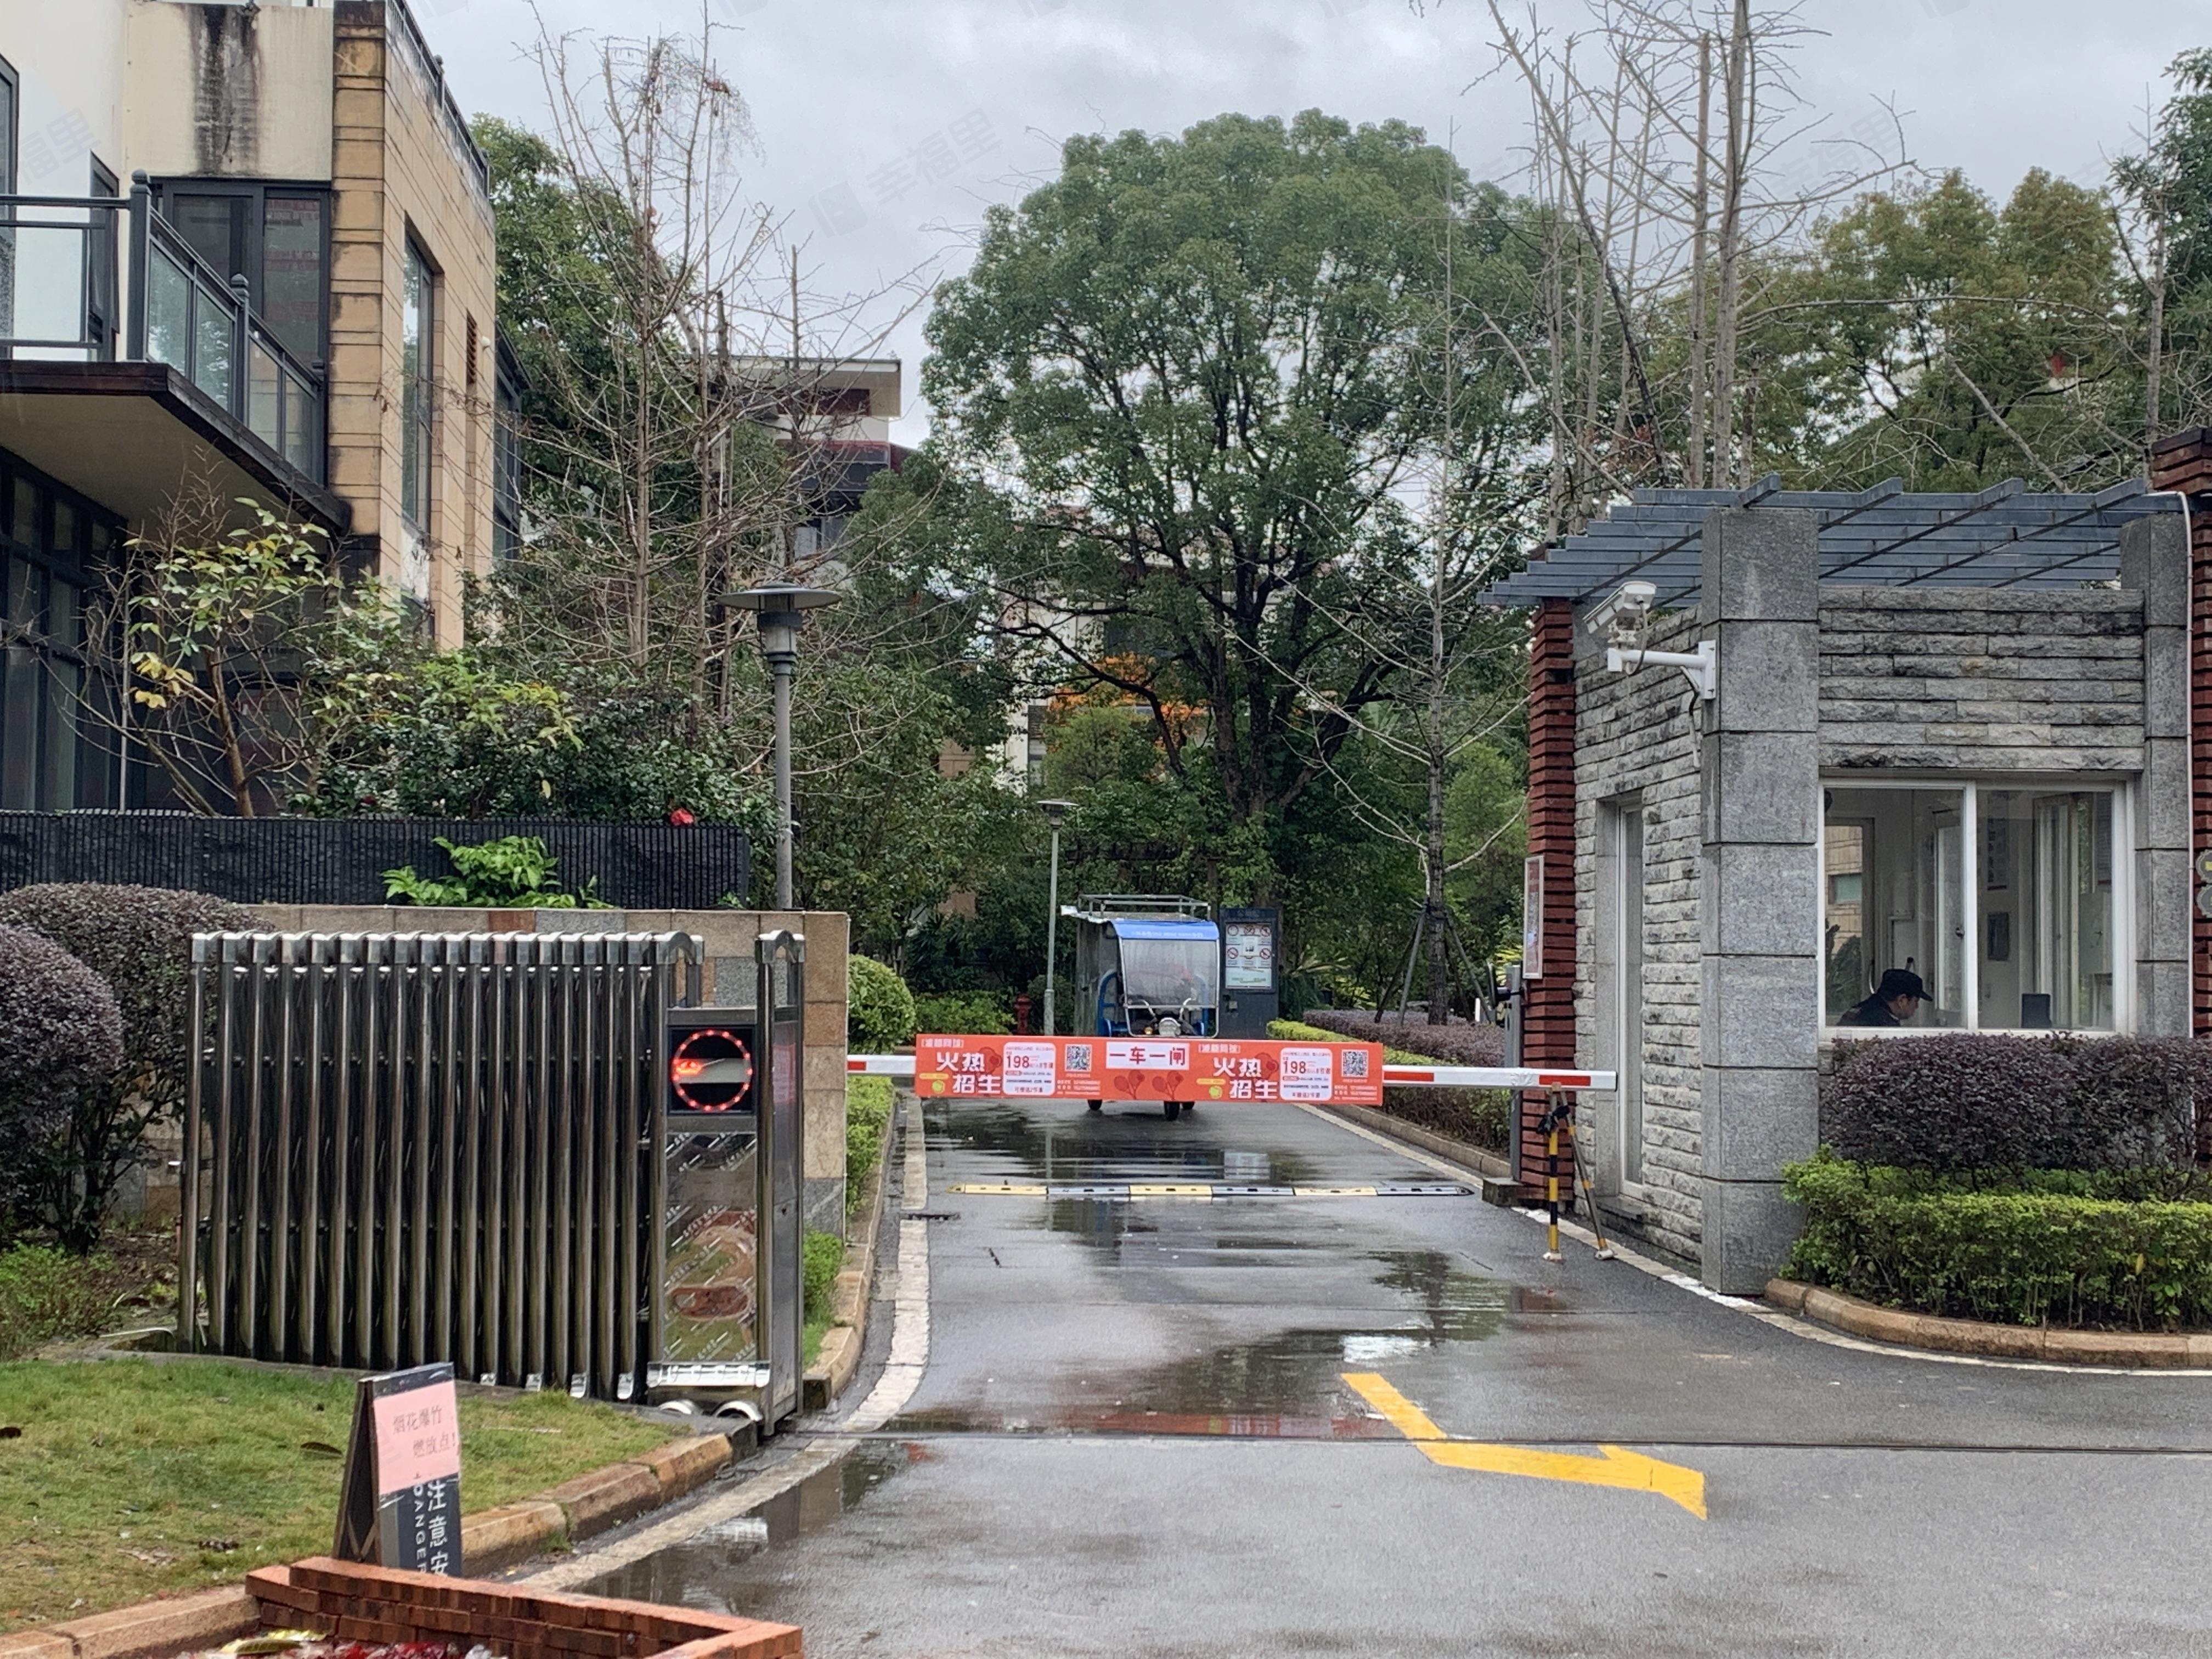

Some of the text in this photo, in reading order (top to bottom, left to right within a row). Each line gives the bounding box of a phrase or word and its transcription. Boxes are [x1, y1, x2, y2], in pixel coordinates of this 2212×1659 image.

[936, 1052, 985, 1072] 火热
[1007, 1055, 1030, 1069] 198
[1109, 1046, 1186, 1065] 一车一闸
[1212, 1057, 1262, 1077] 火热
[1283, 1061, 1306, 1074] 198
[952, 1074, 1001, 1093] 招生
[1229, 1079, 1278, 1099] 招生
[393, 1406, 443, 1435] 烟花爆竹
